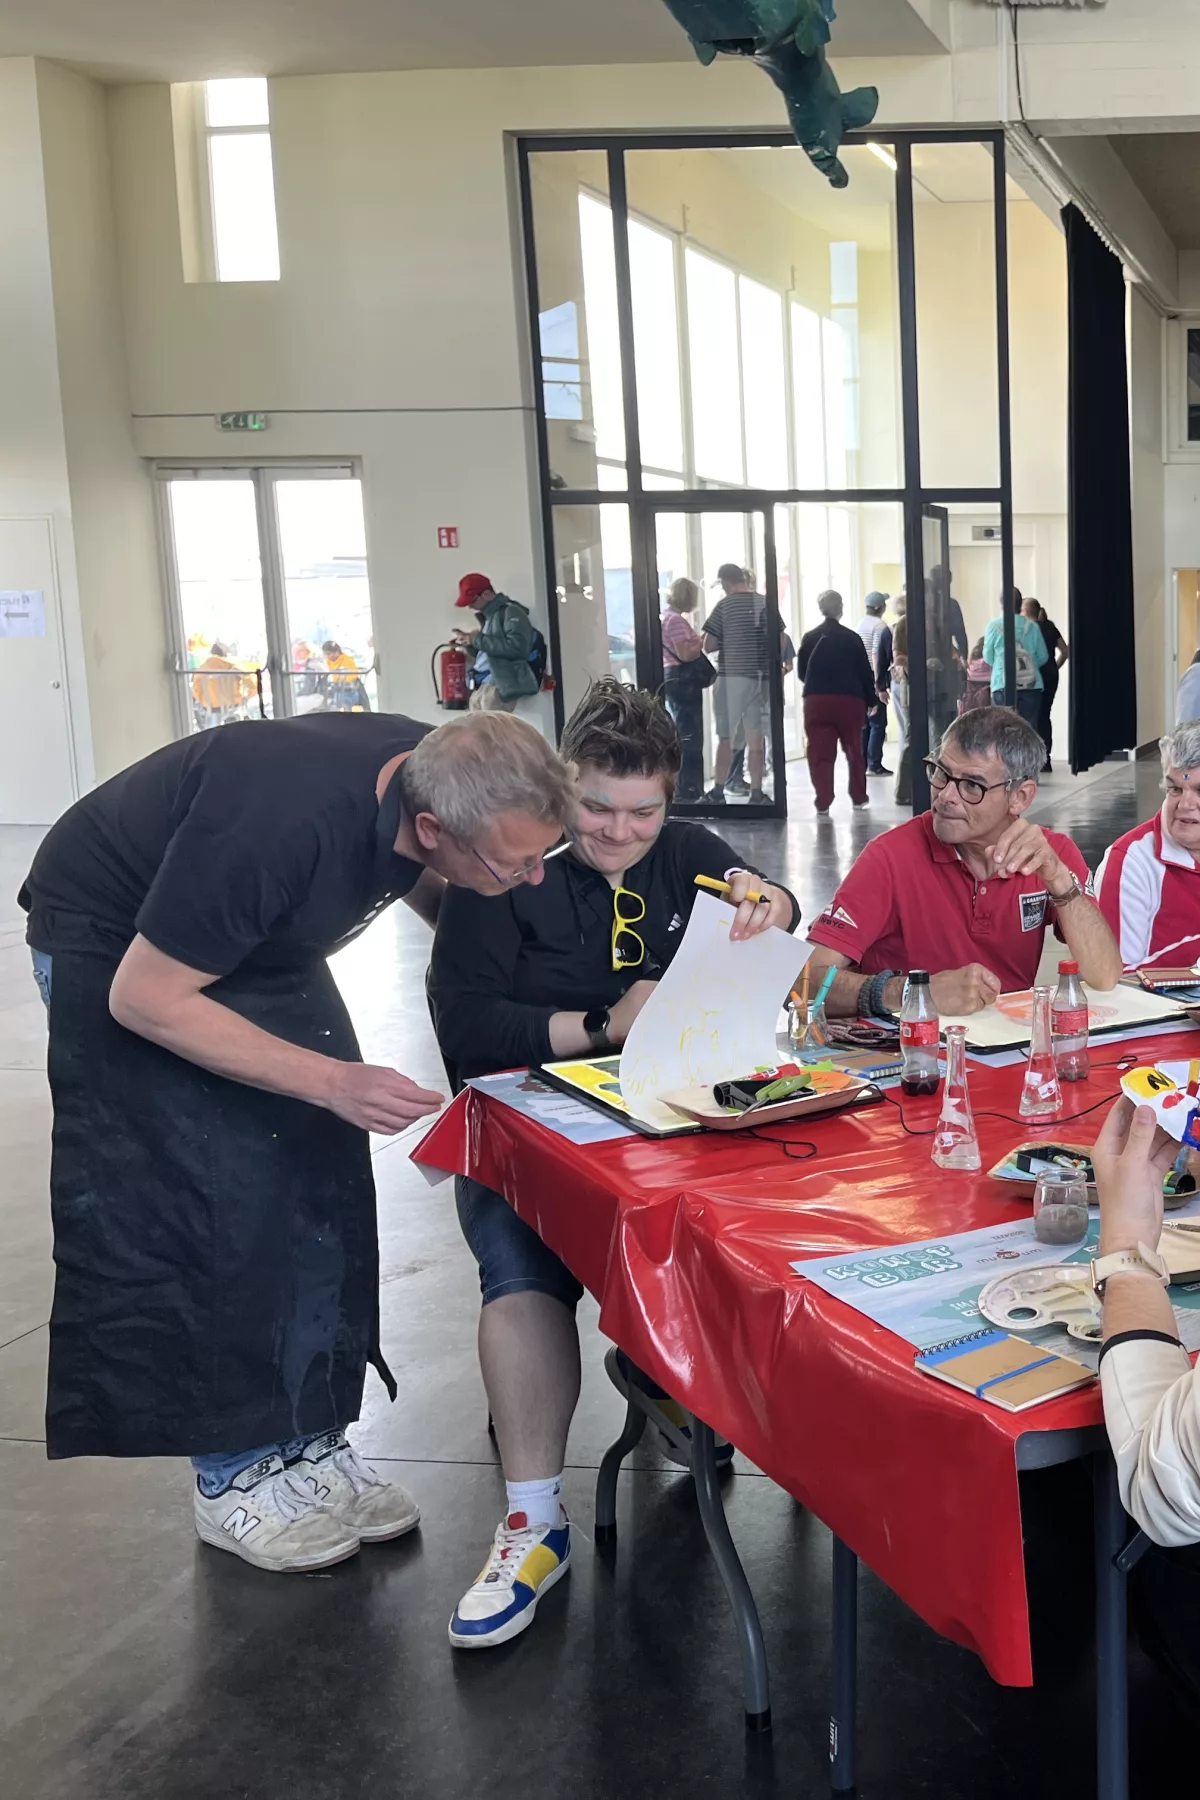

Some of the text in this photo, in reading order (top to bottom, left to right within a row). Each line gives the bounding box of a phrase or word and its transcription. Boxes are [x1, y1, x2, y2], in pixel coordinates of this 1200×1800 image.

[825, 1245, 952, 1280] KUNST
[861, 1259, 959, 1288] BAR
[949, 1299, 978, 1311] SMA
[221, 1506, 261, 1542] N
